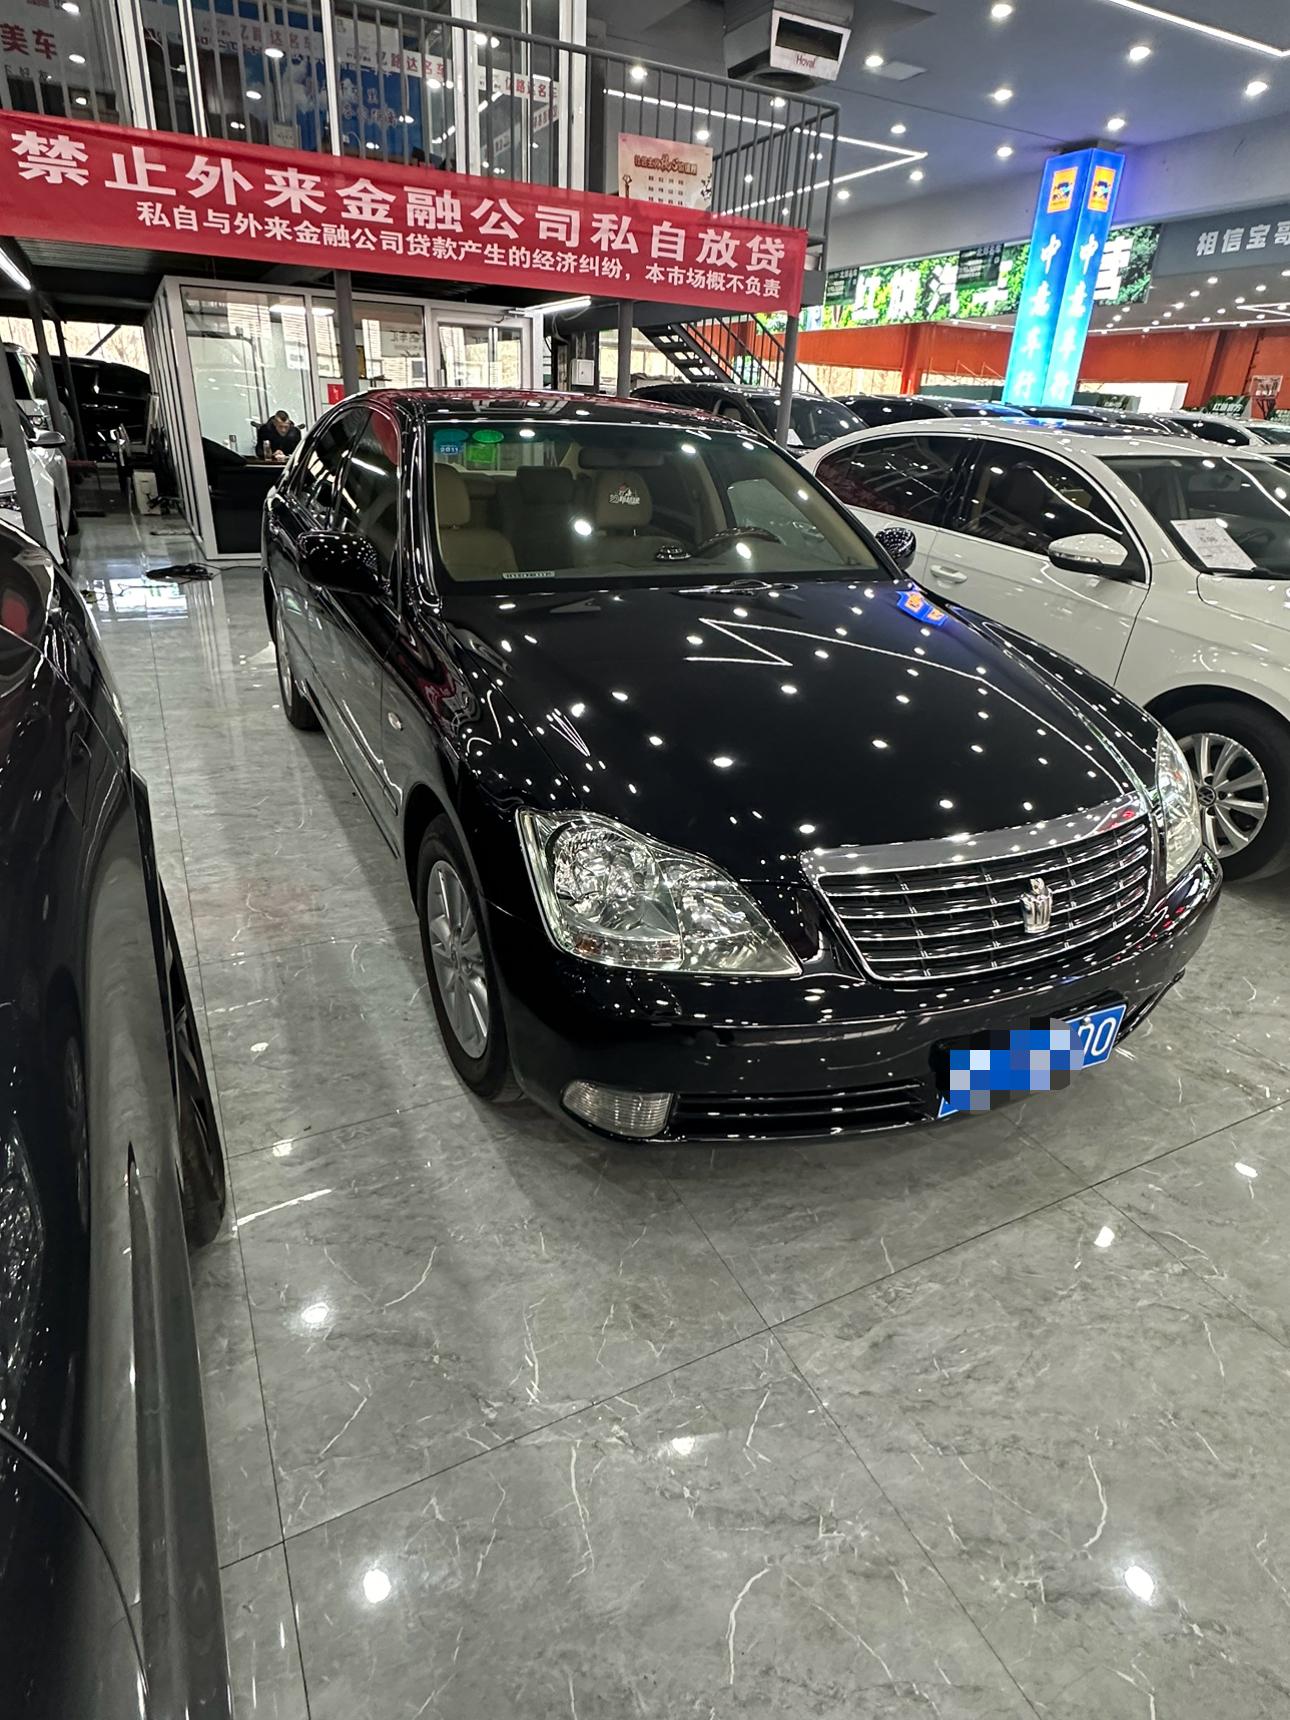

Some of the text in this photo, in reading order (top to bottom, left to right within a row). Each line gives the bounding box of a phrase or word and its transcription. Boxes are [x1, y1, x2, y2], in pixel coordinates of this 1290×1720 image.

[11, 130, 786, 276] 禁止外来金融公司私自放贷
[136, 200, 782, 300] 私自与外来金融公司贷款产生的经济纠纷，本市场概不负责
